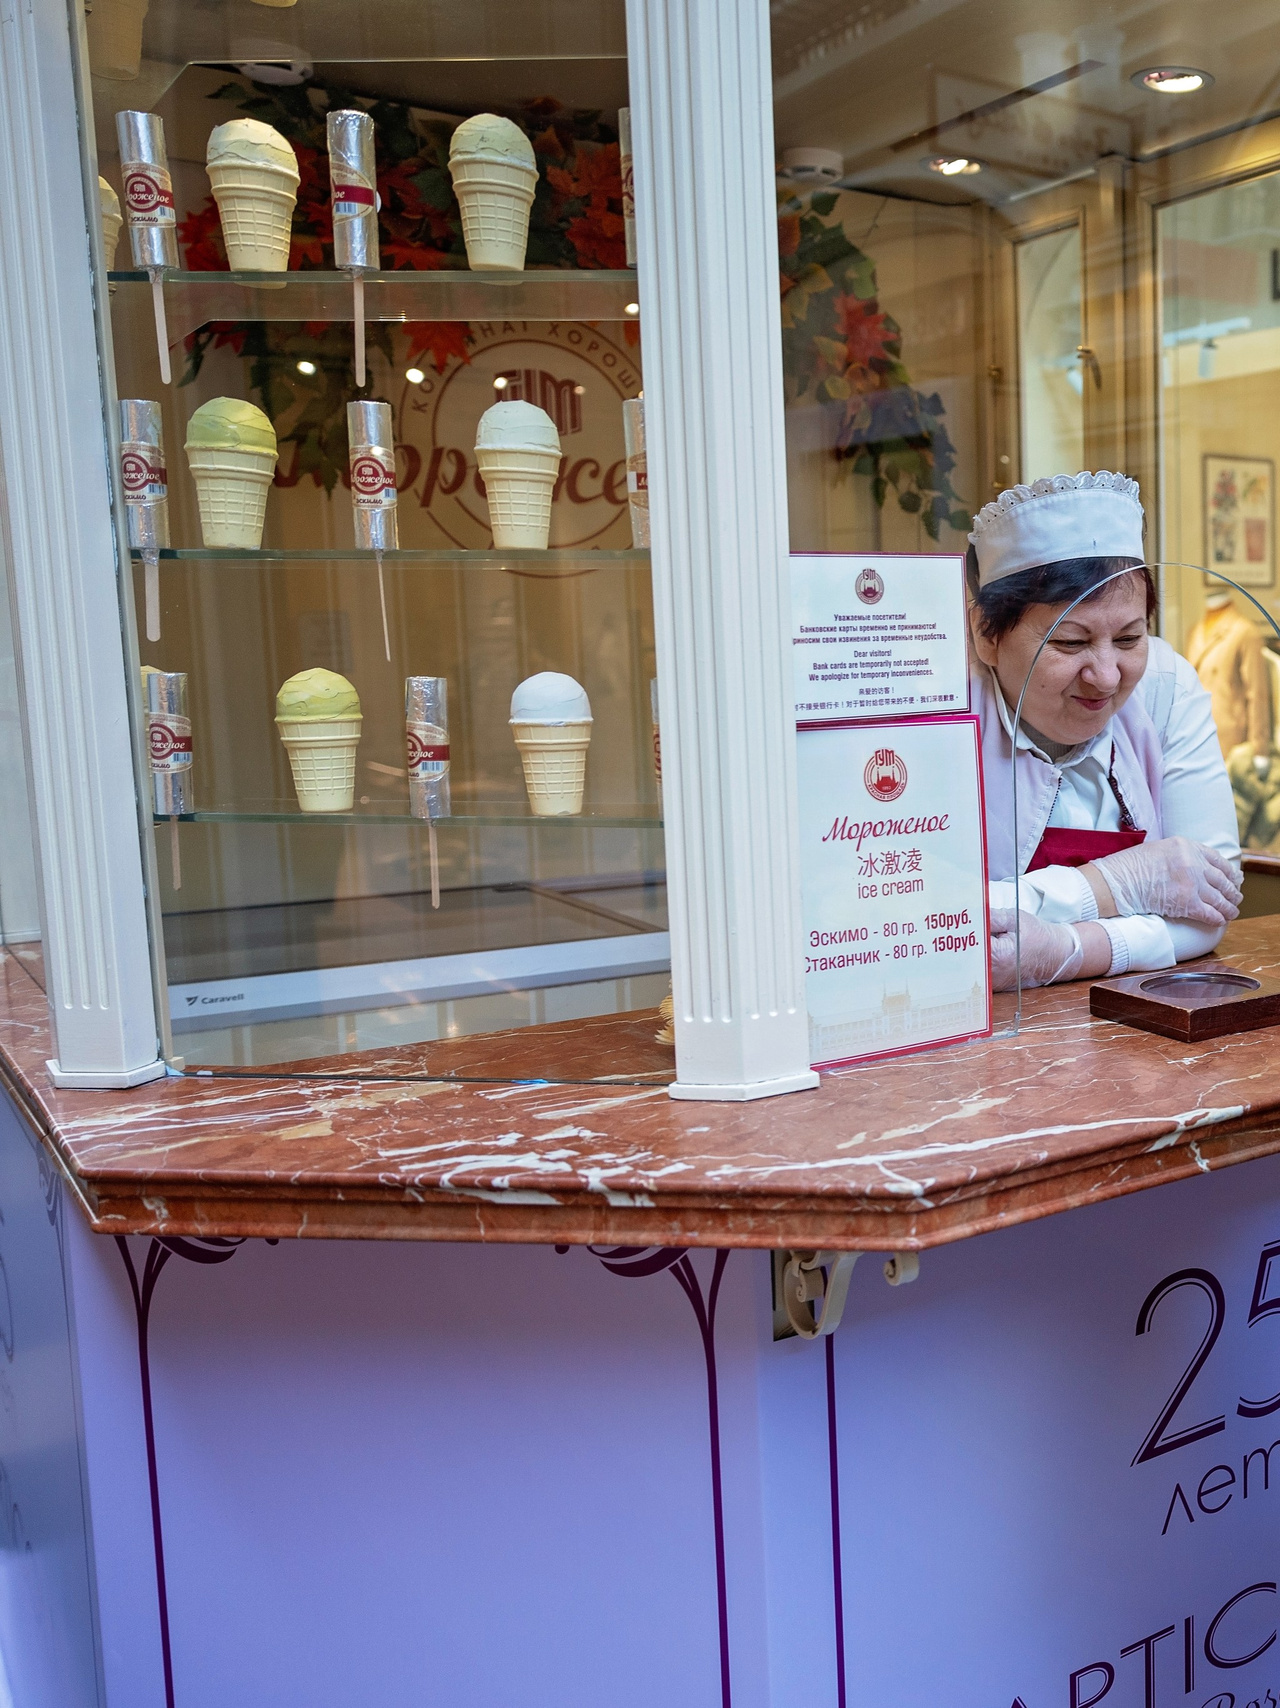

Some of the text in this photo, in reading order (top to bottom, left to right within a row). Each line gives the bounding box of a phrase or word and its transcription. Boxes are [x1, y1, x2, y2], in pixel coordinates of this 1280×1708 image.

[834, 612, 907, 622] Уважаемые посетители!
[799, 625, 838, 634] Банковские
[839, 625, 858, 634] карты
[859, 624, 888, 633] временно
[897, 622, 937, 632] принимаются!
[792, 636, 821, 646] риносим
[822, 636, 837, 644] свои
[838, 635, 871, 643] извинения
[881, 634, 914, 643] временные
[914, 632, 948, 642] неудобства.
[853, 649, 892, 658] Dear visitors!
[812, 662, 829, 671] Bank
[830, 661, 847, 670] cards
[859, 660, 892, 669] temporarily
[893, 659, 902, 667] not
[808, 669, 934, 682] We apologize for temporary inconveniences.
[874, 748, 895, 767] ГУМ
[822, 813, 951, 852] Мороженое
[857, 847, 923, 878] 冰激凌
[858, 878, 924, 900] ice cream
[810, 927, 869, 948] Эскимо
[883, 921, 898, 938] 80
[902, 921, 918, 936] гр.
[924, 908, 972, 931] 150руб.
[893, 944, 908, 960] 80
[911, 943, 928, 959] гр.
[932, 931, 979, 953] 150руб.
[201, 993, 245, 1005] Caravell
